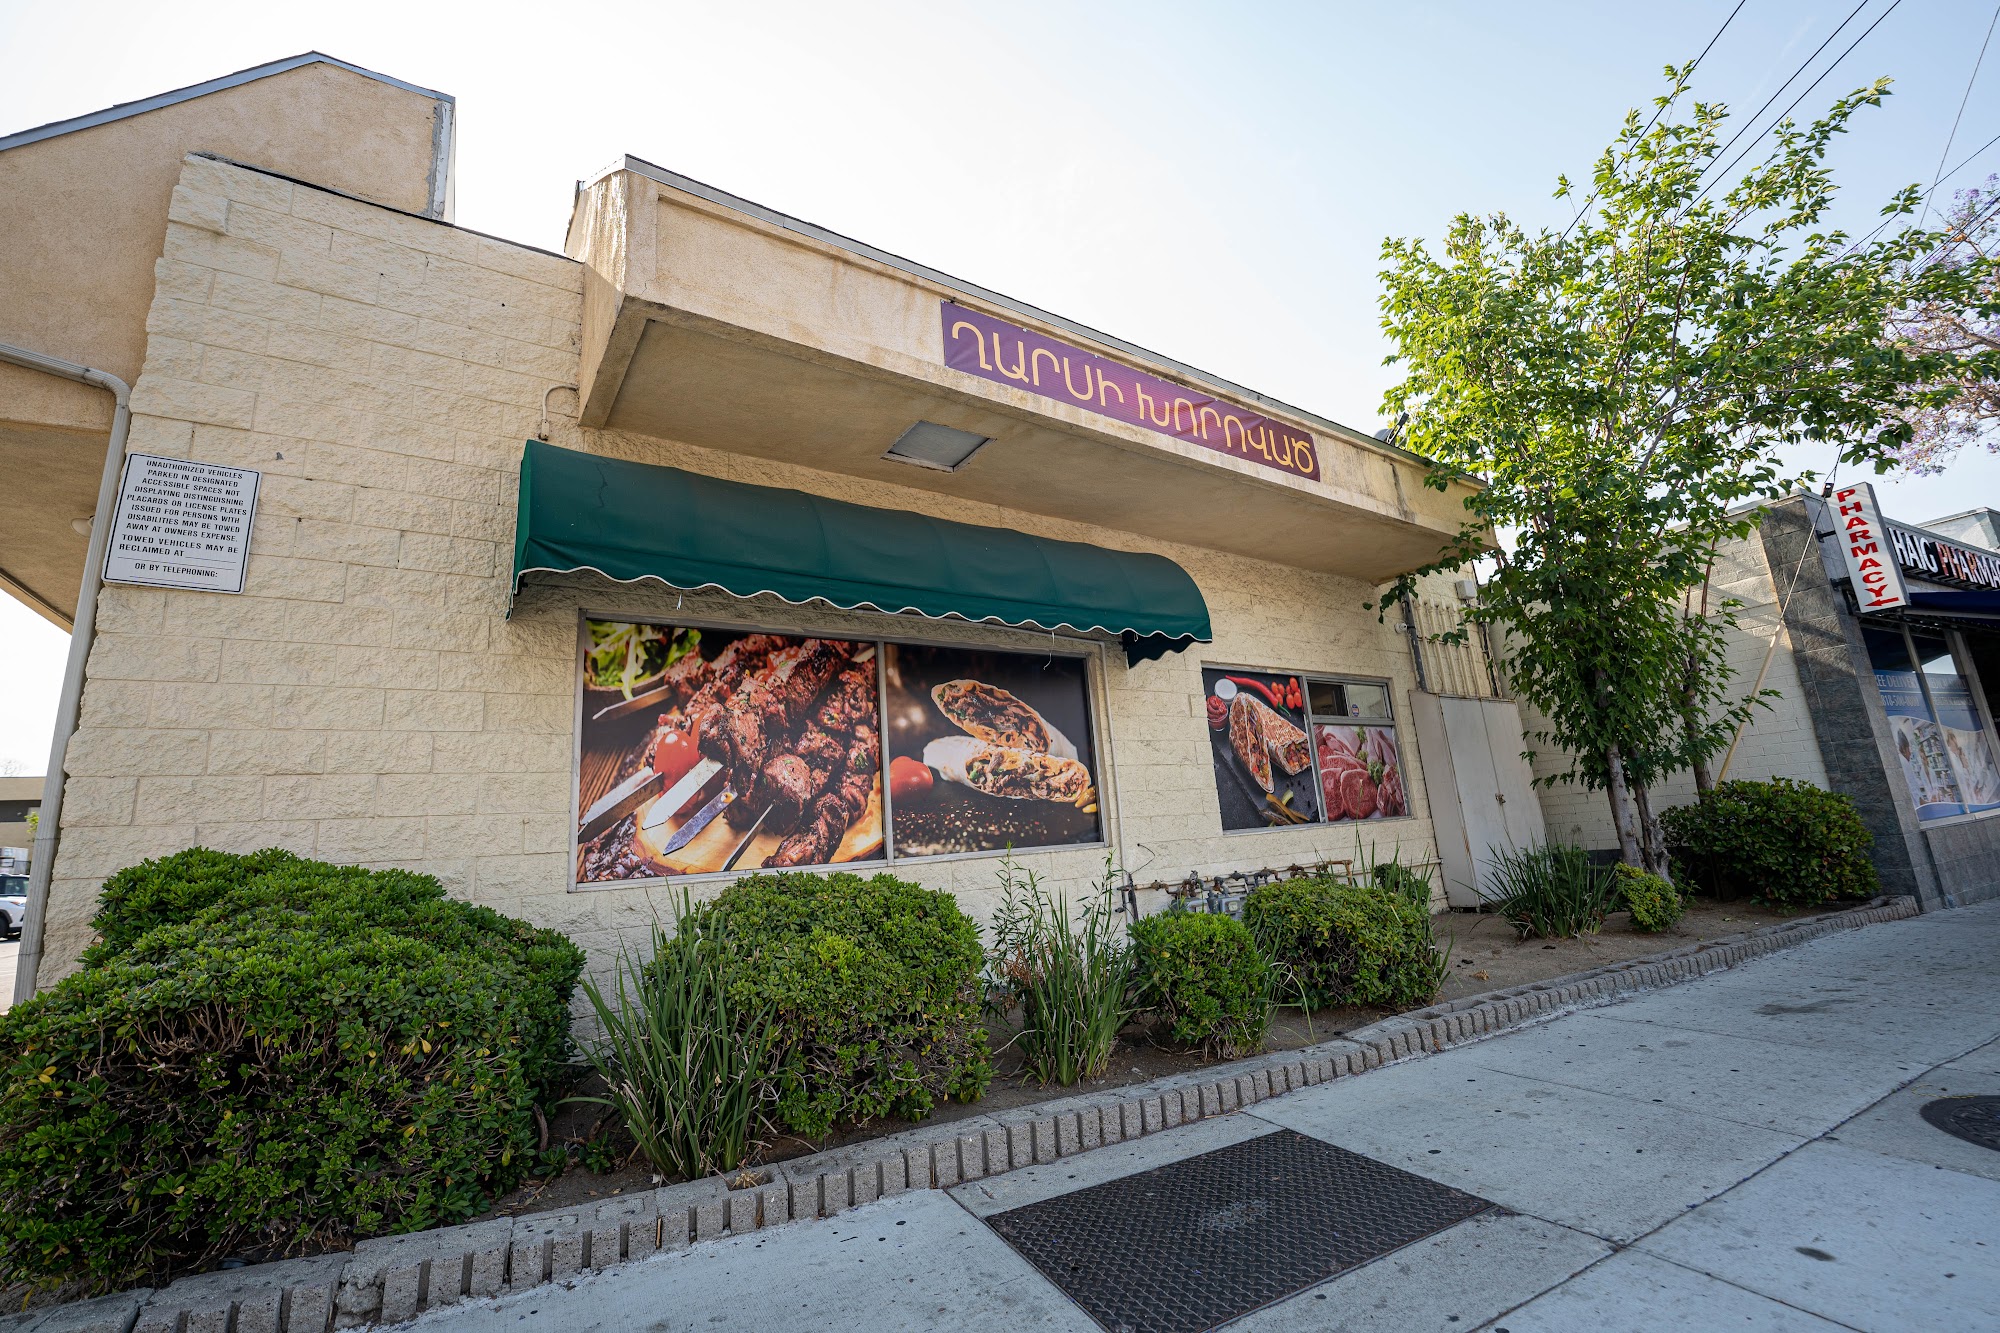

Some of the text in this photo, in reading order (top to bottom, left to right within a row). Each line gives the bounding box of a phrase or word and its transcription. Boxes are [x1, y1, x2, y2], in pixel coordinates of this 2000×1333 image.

[147, 460, 242, 479] UNAUTHORIZED VEHICLES
[148, 469, 178, 479] PARKED
[193, 476, 238, 487] DESIGNATED
[142, 478, 190, 489] ACCESSIBLE
[194, 485, 222, 494] SPACES
[127, 495, 168, 505] PLACARDS
[185, 502, 217, 511] LICENSE
[220, 507, 247, 515] PLATES
[135, 486, 243, 506] DISPLAYING DISTINGUISHING
[132, 505, 161, 513] ISSUED
[182, 511, 218, 521] PERSONS
[128, 514, 178, 525] DISABILITIES
[214, 525, 240, 533] TOWED
[164, 528, 198, 537] OWNERS
[119, 544, 170, 555] RECLAIMED
[122, 534, 153, 543] TOWED
[159, 539, 201, 549] VEHICLES
[206, 544, 224, 552] MAY
[1837, 489, 1888, 598] PHARMACY
[163, 566, 218, 577] TELEPHONING:
[1935, 542, 2000, 588] PHARMA
